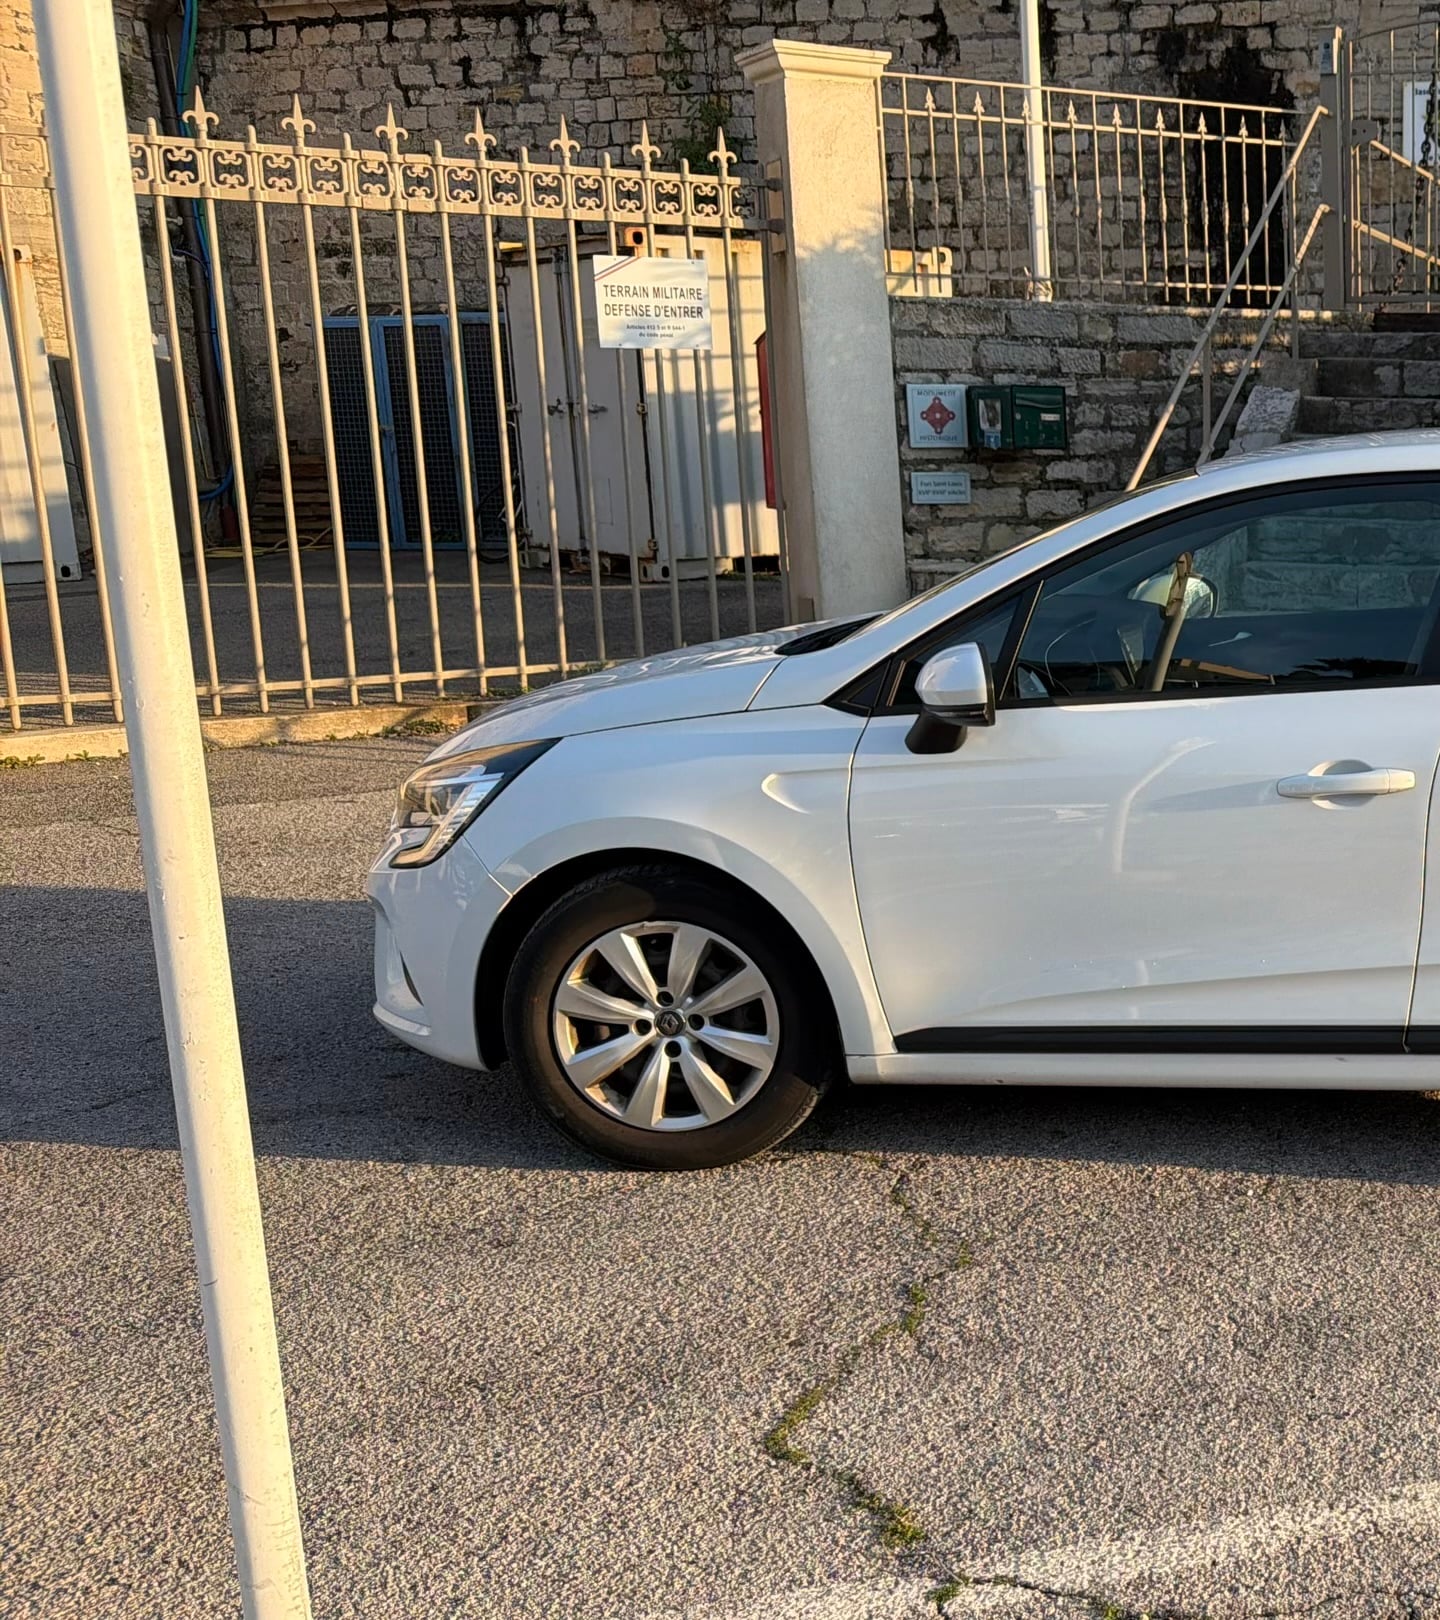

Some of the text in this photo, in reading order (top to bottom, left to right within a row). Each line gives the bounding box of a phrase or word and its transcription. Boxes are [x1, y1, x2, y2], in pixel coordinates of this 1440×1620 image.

[603, 284, 704, 301] TERRAIN MILITAIRE
[604, 303, 704, 319] DEFENSE D'ENTRER
